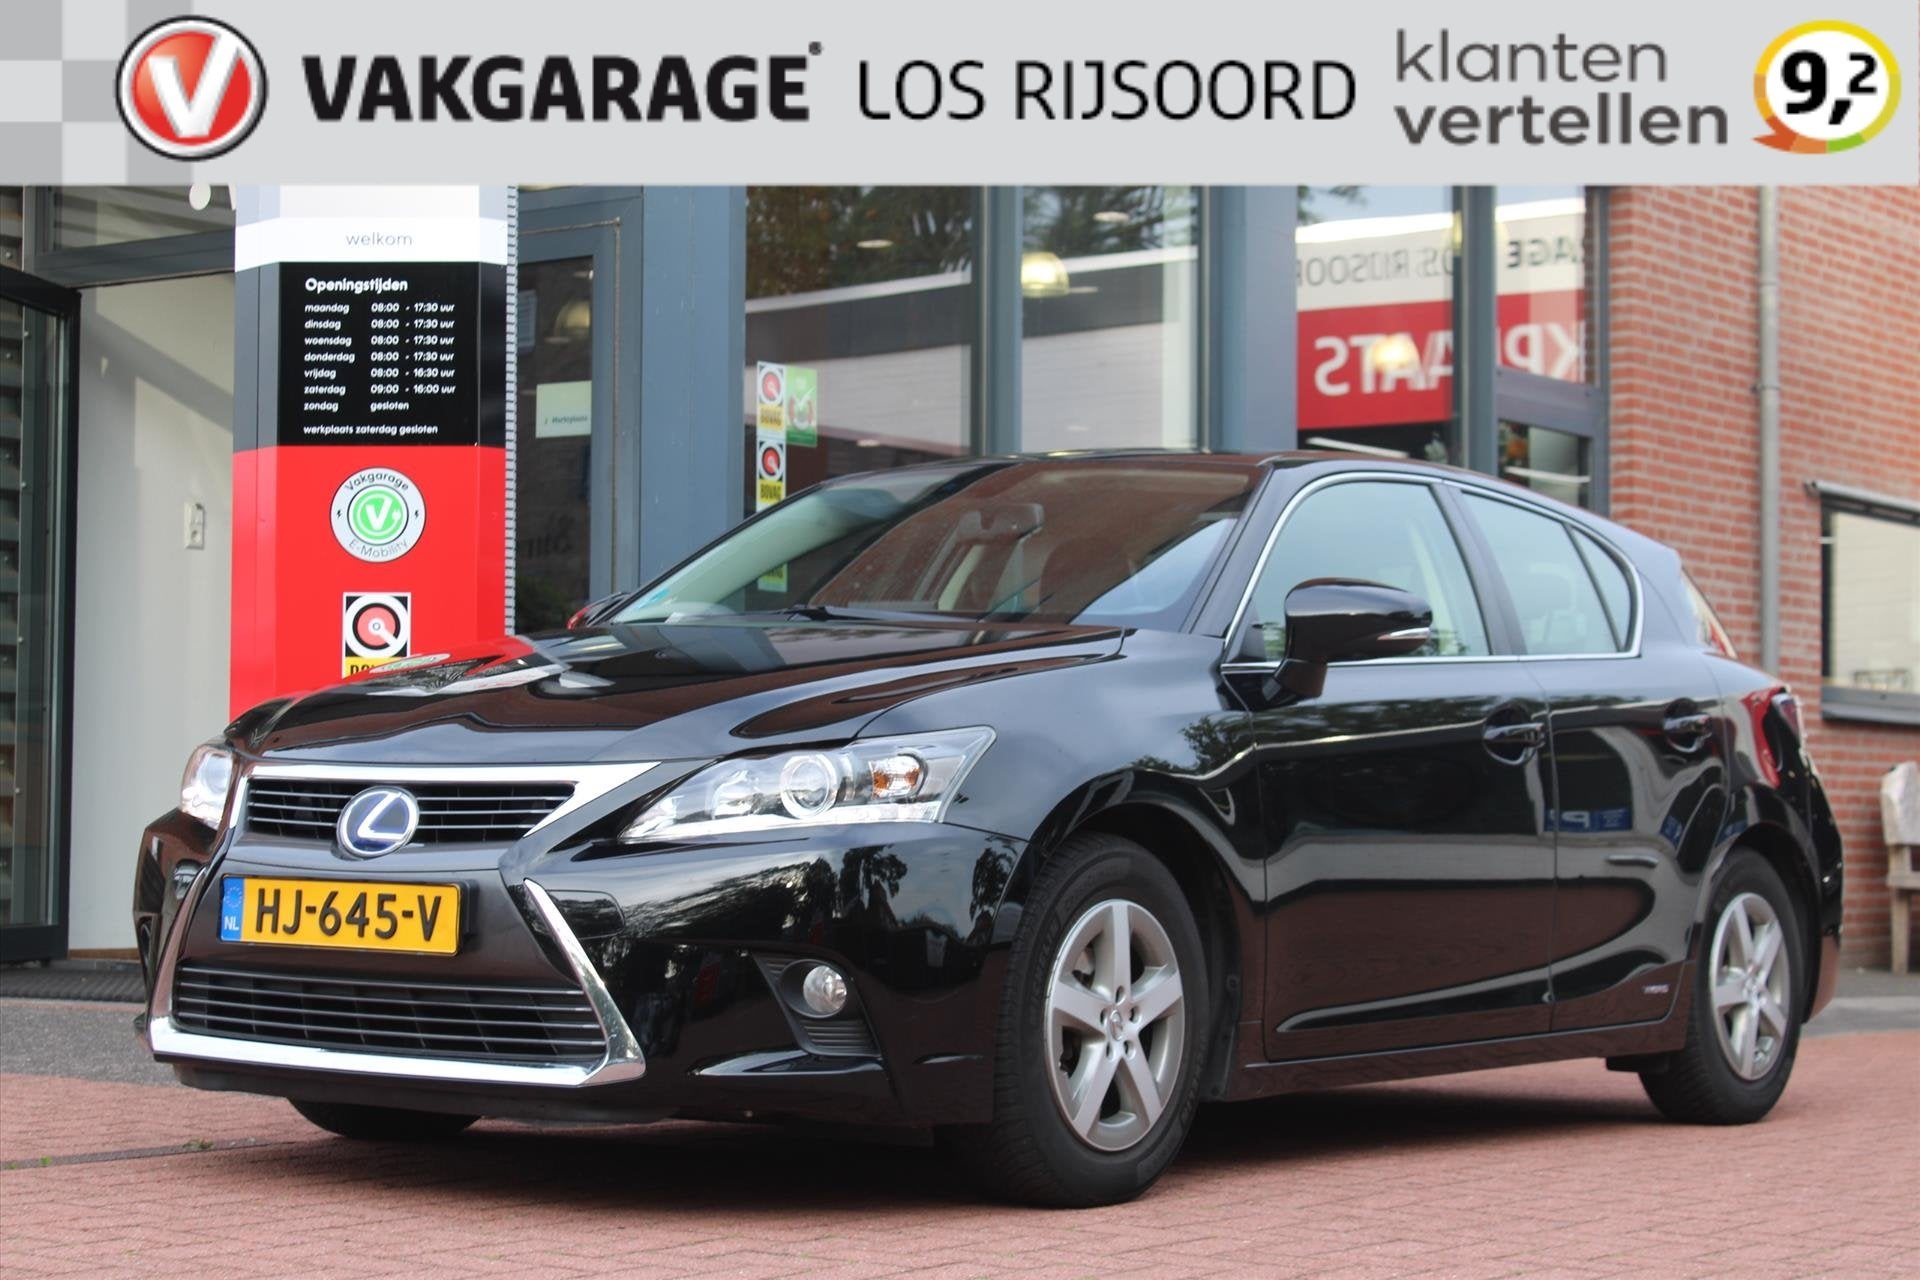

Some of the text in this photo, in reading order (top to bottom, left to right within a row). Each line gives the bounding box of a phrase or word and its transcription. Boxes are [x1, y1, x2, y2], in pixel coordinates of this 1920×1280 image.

[346, 232, 412, 245] welkom
[305, 278, 408, 294] Openingstijden
[305, 303, 349, 314] maandag
[371, 303, 399, 312] 08:00
[414, 303, 438, 312] 17:30
[440, 304, 455, 312] uur
[305, 319, 341, 330] dinsdag
[371, 319, 399, 328] 08:00
[414, 319, 438, 328] 17:30
[305, 336, 352, 347] woensdag
[371, 335, 399, 345] 08:00
[414, 335, 438, 345] 17:30
[440, 337, 454, 345] uur
[304, 352, 355, 363] donderdag
[371, 352, 399, 361] 08:00
[414, 352, 438, 361] 17:30
[440, 353, 454, 361] uur
[304, 368, 336, 379] vrijdag
[371, 368, 399, 377] 08:00
[414, 368, 438, 377] 16:30
[304, 385, 346, 396] zaterdag
[371, 384, 399, 394] 09:00
[414, 384, 439, 393] 16:00
[304, 401, 409, 412] zondag gesloten
[304, 425, 438, 435] werkplaats zaterdag gesloten
[345, 473, 409, 491] Vakgarage
[349, 539, 407, 557] E-Mobility
[255, 888, 442, 941] HJ-645-V
[224, 916, 240, 931] NL
